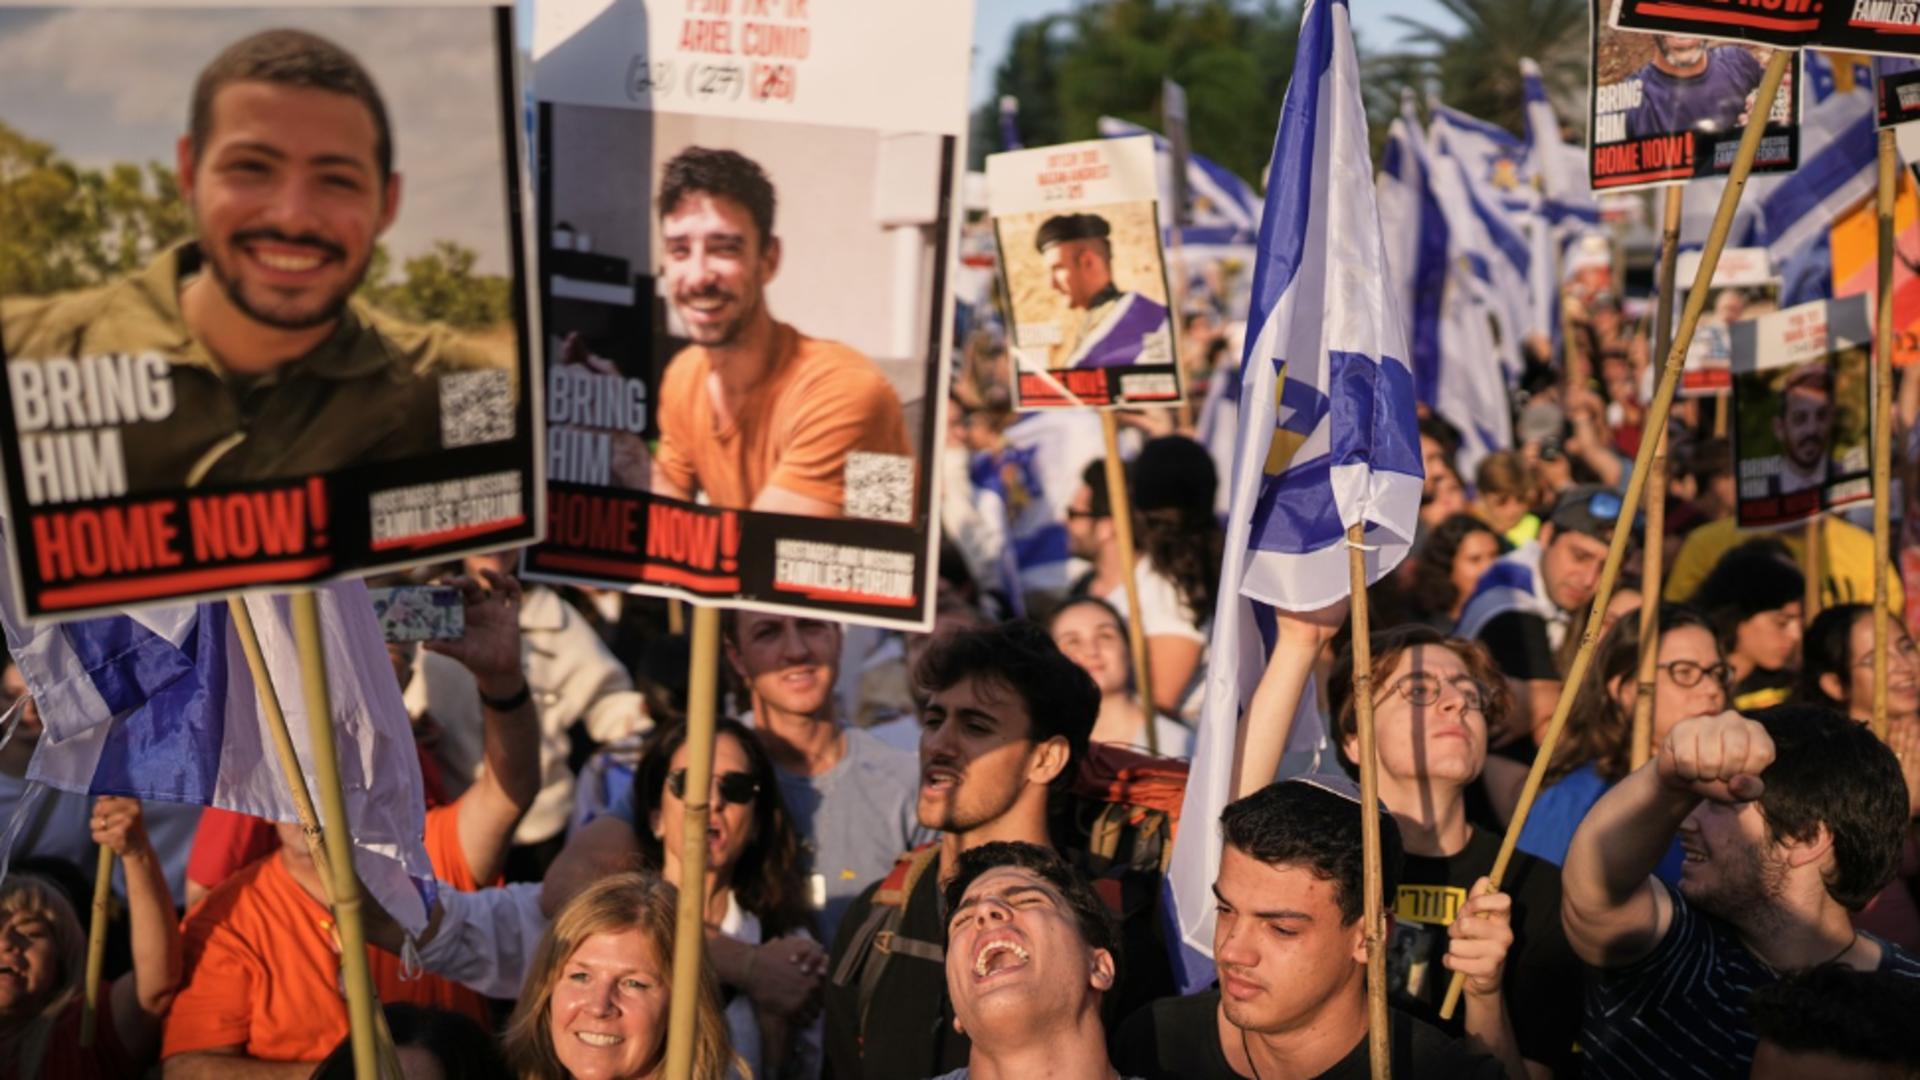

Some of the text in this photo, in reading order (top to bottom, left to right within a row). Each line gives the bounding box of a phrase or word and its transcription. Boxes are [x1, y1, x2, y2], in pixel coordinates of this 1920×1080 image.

[679, 19, 732, 55] ARIEL
[1595, 111, 1627, 143] HIM
[1597, 79, 1643, 113] BRING
[1595, 131, 1694, 175] HOME NOW!
[8, 351, 175, 433] BRING
[548, 369, 647, 433] BRING
[20, 427, 127, 505] HIM
[547, 425, 611, 487] HIM
[32, 475, 327, 582] HOME NOW!
[547, 492, 740, 573] HOME NOW!
